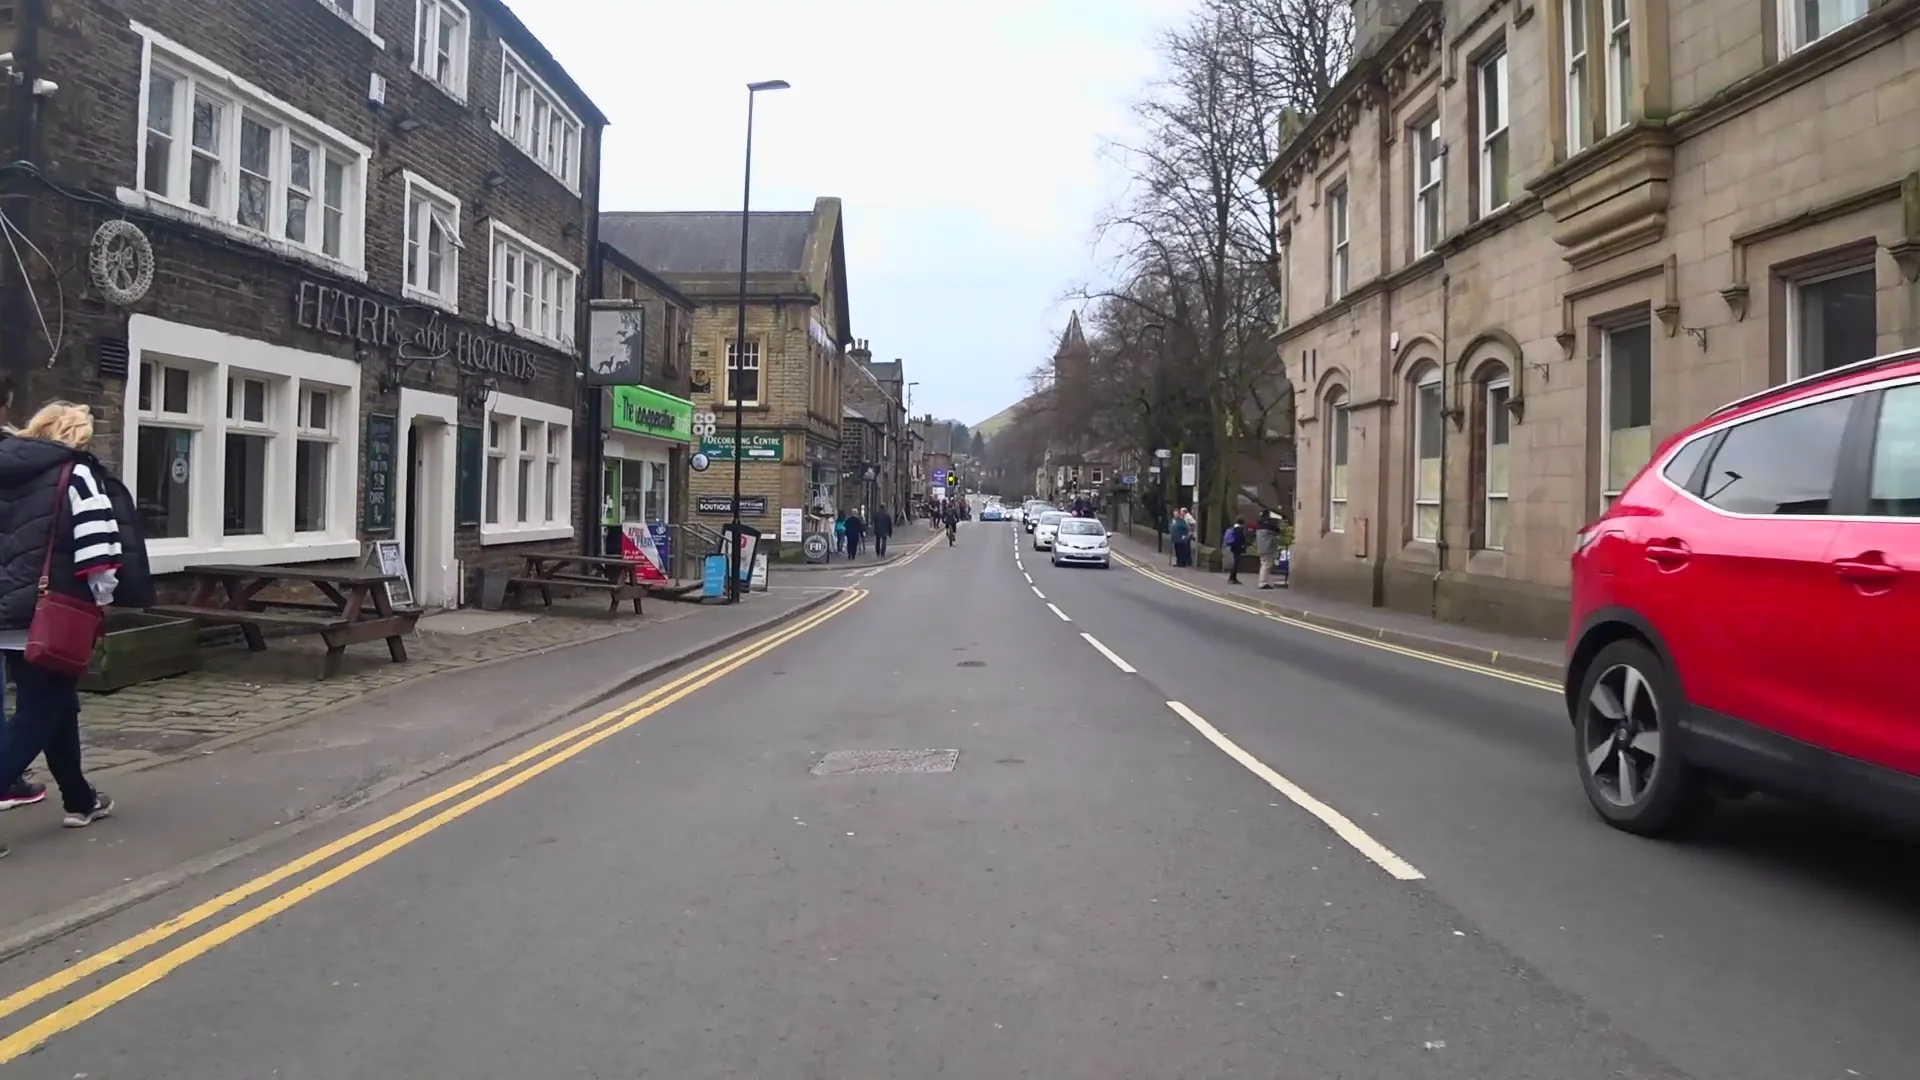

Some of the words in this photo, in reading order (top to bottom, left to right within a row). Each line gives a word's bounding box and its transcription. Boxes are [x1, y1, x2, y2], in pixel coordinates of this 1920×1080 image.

[414, 311, 451, 354] and
[457, 332, 537, 380] HOUNDS
[622, 395, 634, 422] The
[700, 503, 731, 511] BOUTIQUE
